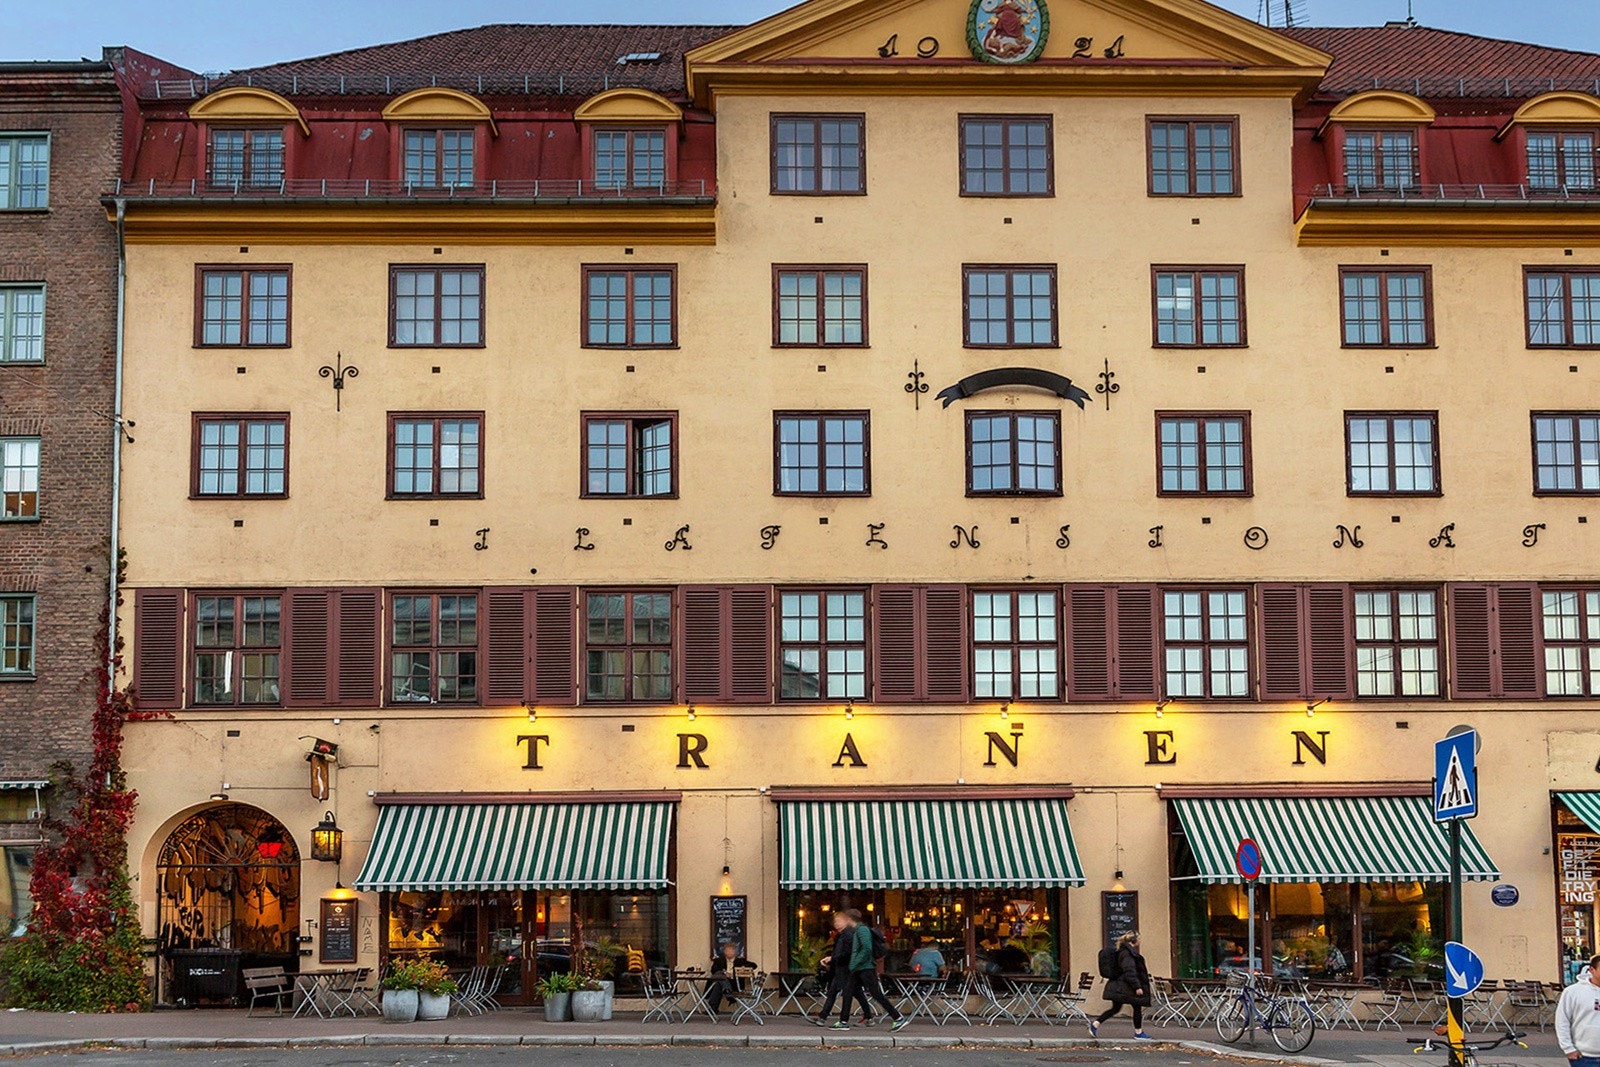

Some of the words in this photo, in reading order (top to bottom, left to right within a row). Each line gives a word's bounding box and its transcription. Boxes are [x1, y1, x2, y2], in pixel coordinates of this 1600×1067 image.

[517, 731, 1329, 769] TRANEN
[1562, 850, 1594, 860] GET
[1565, 871, 1592, 881] DIE
[1562, 881, 1596, 892] TRY
[1565, 892, 1594, 903] ING
